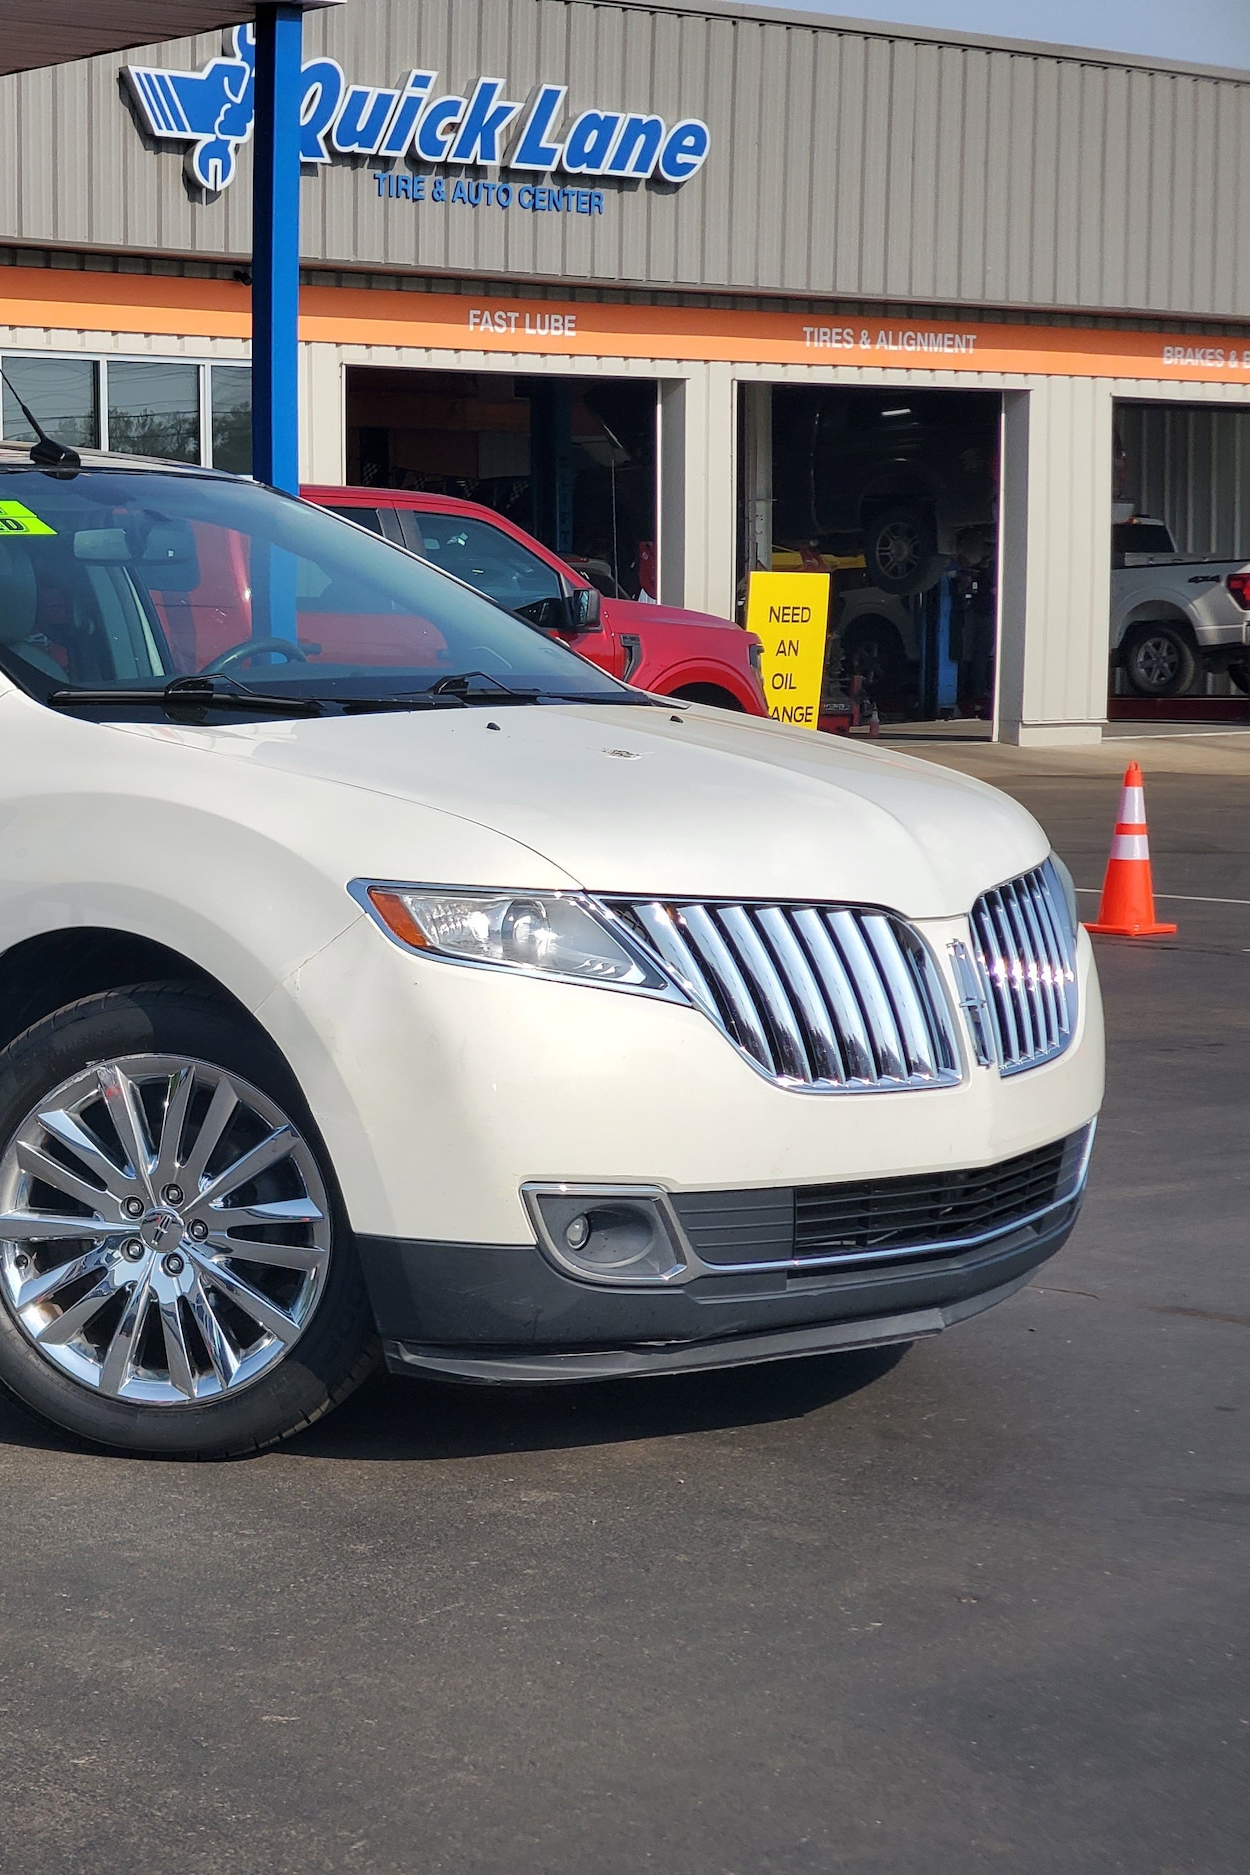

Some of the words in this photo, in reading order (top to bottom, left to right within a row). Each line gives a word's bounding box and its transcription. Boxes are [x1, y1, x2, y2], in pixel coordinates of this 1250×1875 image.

[511, 83, 711, 183] Lane
[374, 172, 426, 201] TIRE
[432, 177, 447, 202] &
[452, 180, 513, 207] AUTO
[518, 185, 605, 214] CENTER
[469, 309, 519, 334] FAST
[525, 313, 577, 337] LUBE
[802, 326, 854, 349] TIRES
[859, 329, 872, 350] &
[875, 330, 977, 354] ALIGNMENT
[1163, 345, 1225, 368] BRAKES
[1228, 350, 1238, 369] &
[768, 606, 811, 623] NEED
[775, 639, 800, 657] AN
[771, 672, 797, 690] OIL
